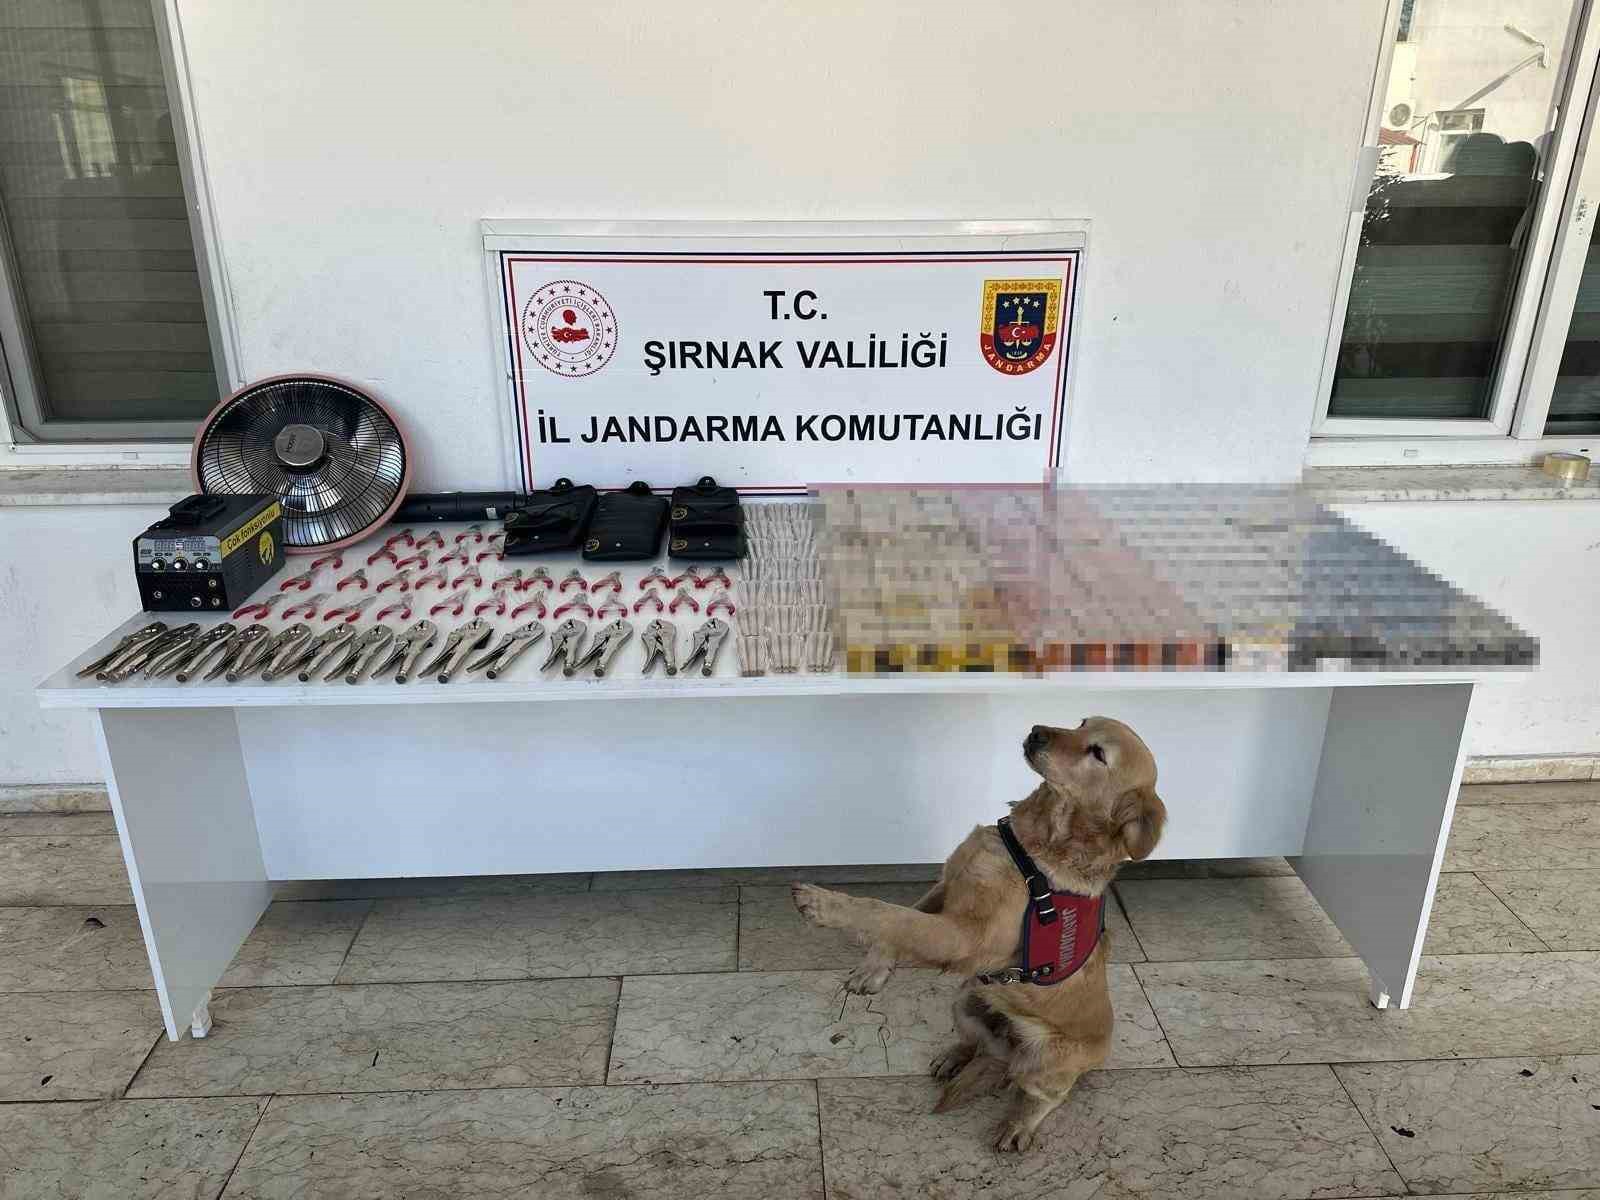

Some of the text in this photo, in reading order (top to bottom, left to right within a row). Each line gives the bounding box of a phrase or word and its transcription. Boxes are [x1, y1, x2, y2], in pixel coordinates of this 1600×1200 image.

[763, 289, 828, 321] T.C.
[643, 331, 947, 377] ŞIRNAK VALİLİĞİ
[983, 343, 1052, 373] JANDARMA
[537, 406, 1042, 444] İL JANDARMA KOMUTANLIĞI
